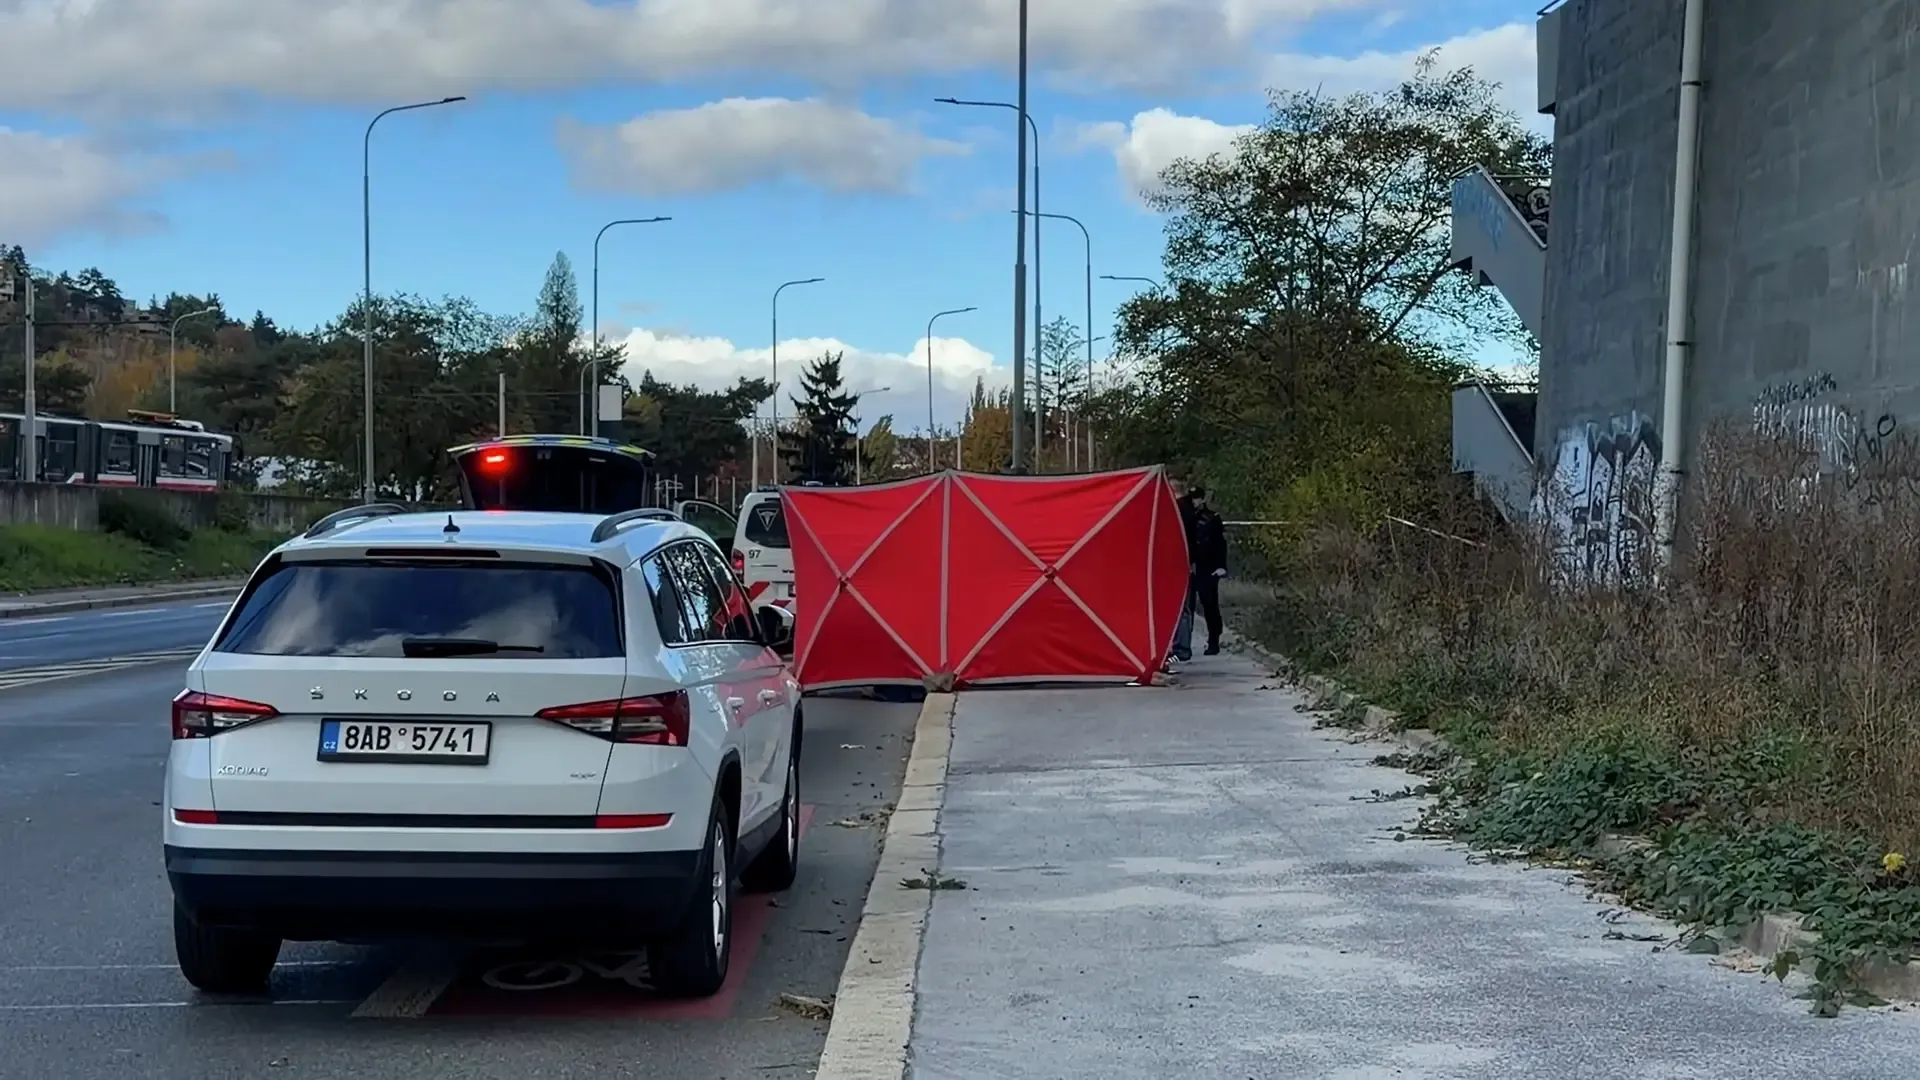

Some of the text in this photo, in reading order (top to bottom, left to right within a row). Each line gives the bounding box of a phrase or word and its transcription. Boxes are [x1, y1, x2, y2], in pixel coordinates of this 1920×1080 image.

[748, 549, 761, 559] 97
[344, 725, 475, 752] 8AB 5741
[323, 741, 336, 749] CZ
